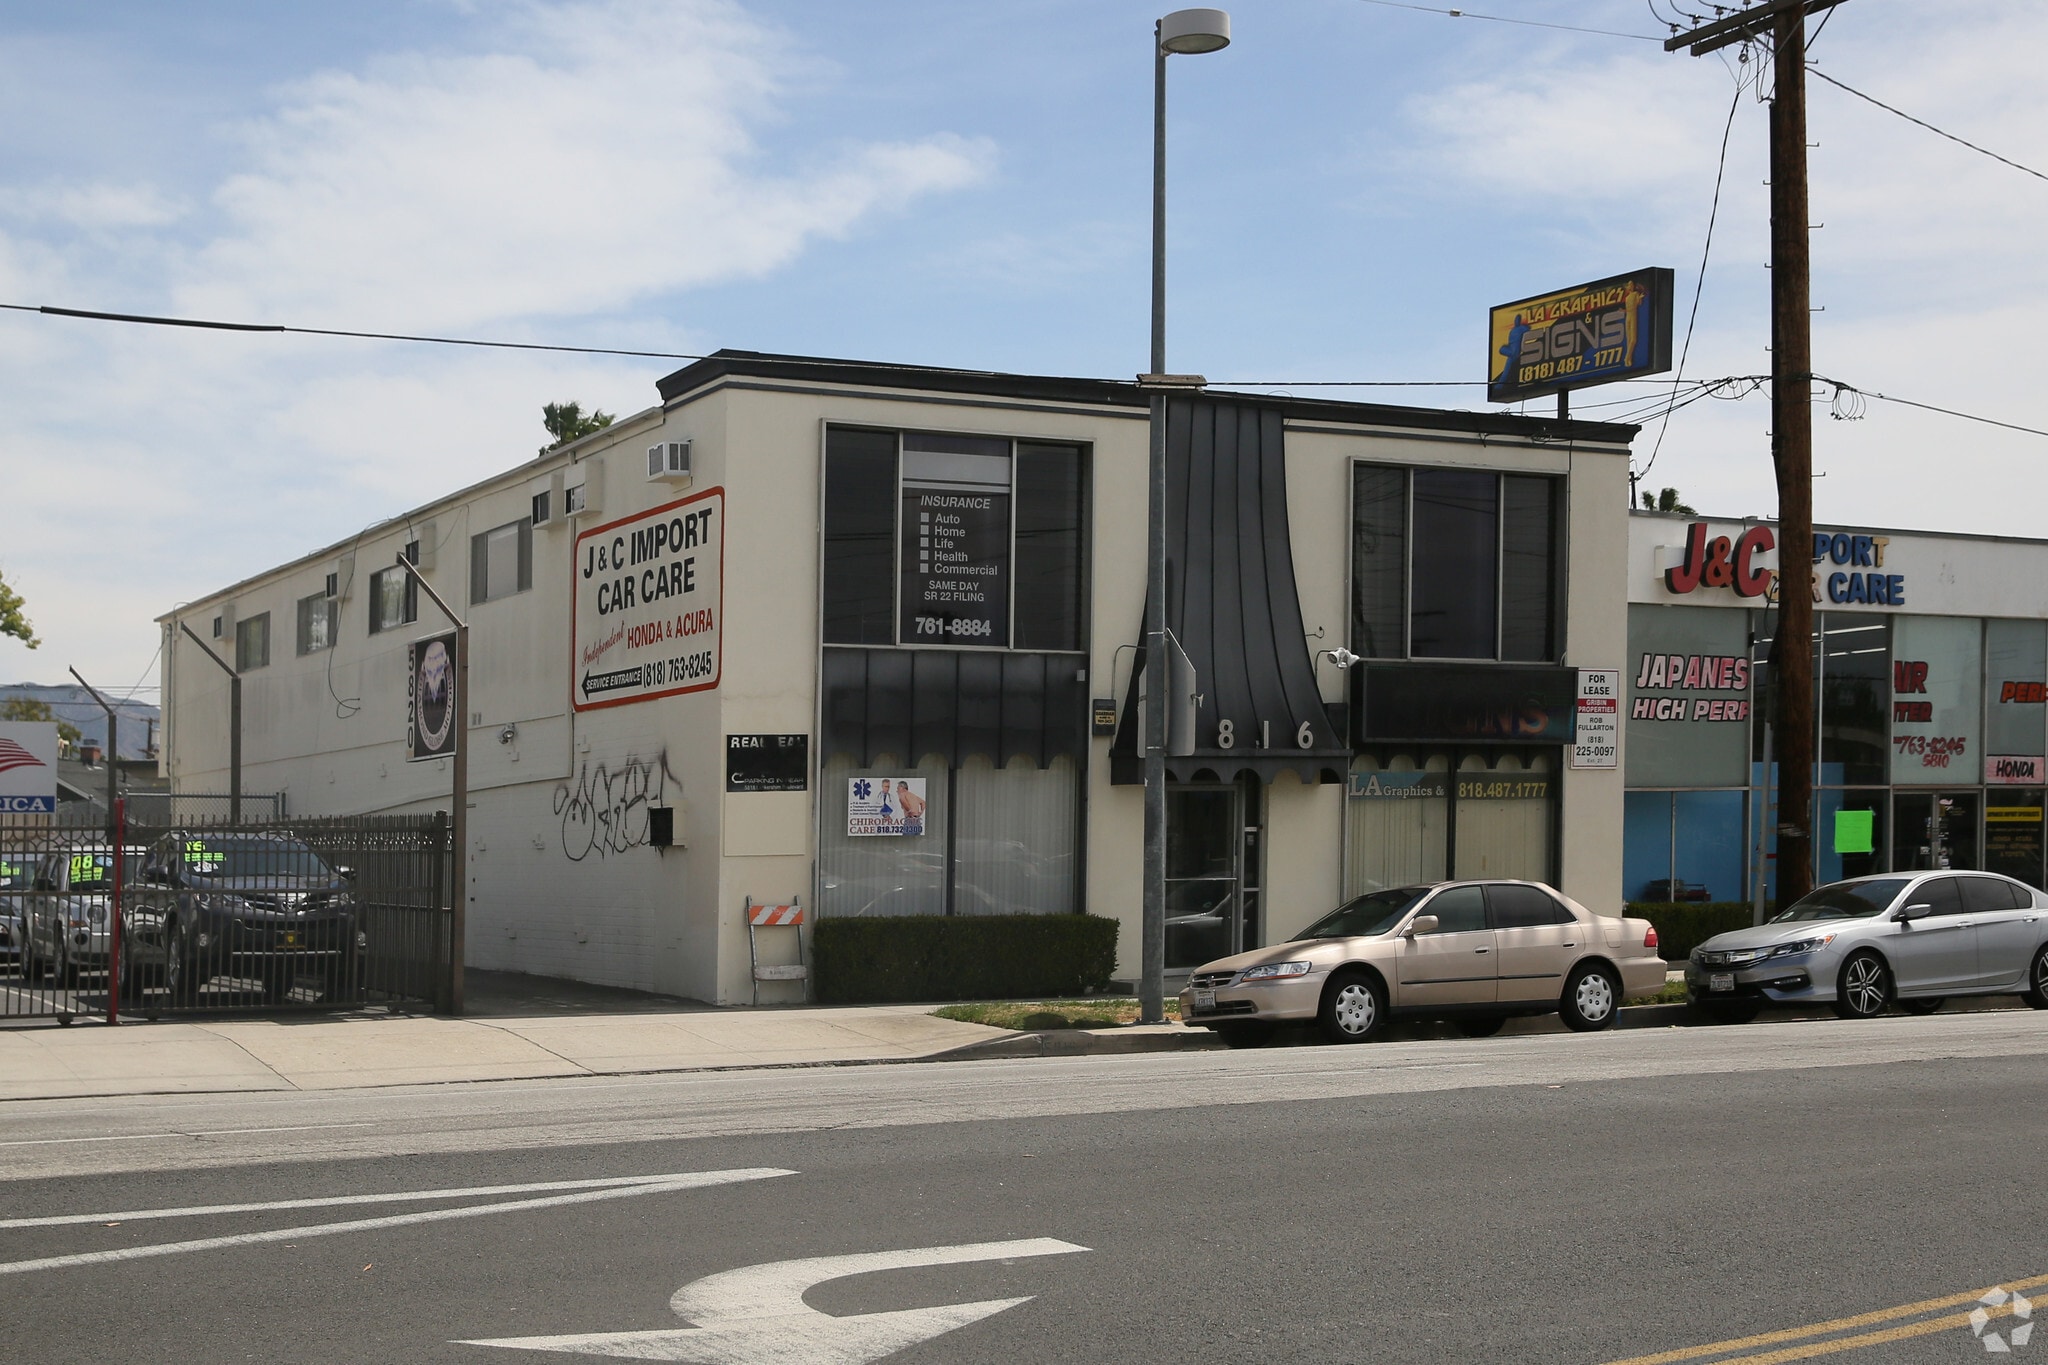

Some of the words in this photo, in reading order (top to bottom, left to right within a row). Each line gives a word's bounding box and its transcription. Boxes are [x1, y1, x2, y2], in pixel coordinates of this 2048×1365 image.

[1527, 306, 1544, 324] LA
[1550, 287, 1625, 319] GRAPHICS
[1585, 312, 1592, 323] &
[1520, 310, 1625, 365] SIGNS
[1519, 361, 1554, 383] (818)
[1557, 356, 1582, 375] 487
[1594, 347, 1622, 367] 1777
[920, 495, 990, 509] INSURANCE
[935, 513, 960, 524] Auto
[934, 526, 965, 536] Home
[584, 546, 594, 579] J
[598, 546, 607, 571] &
[612, 537, 624, 570] C
[631, 508, 712, 566] IMPORT
[934, 538, 954, 548] Life
[934, 551, 968, 562] Health
[1665, 523, 1775, 597] J&C
[934, 564, 998, 575] Commercial
[598, 575, 635, 615] CAR
[641, 557, 694, 603] CARE
[929, 581, 956, 589] SAME
[959, 582, 979, 591] DAY
[1764, 569, 1822, 603] CR
[1829, 572, 1904, 605] CARE
[924, 592, 937, 600] SR
[940, 592, 951, 600] 22
[954, 593, 984, 601] FILING
[915, 618, 991, 636] 761-8884
[582, 620, 624, 666] Independent
[628, 620, 663, 648] HONDA
[666, 620, 672, 638] &
[675, 608, 713, 638] ACURA
[586, 672, 609, 690] SERVICE
[610, 669, 641, 686] ENTRANCE
[643, 660, 666, 688] (818)
[668, 651, 712, 682] 763-8245
[1636, 653, 1748, 691] JAPANES
[1589, 675, 1605, 683] FOR
[1584, 687, 1609, 695] LEASE
[1632, 697, 1688, 721] HIGH
[1576, 747, 1614, 756] 225-0097
[1922, 754, 1949, 768] 5810
[1996, 760, 2034, 778] HONDA
[1350, 775, 1382, 796] LA
[1384, 786, 1432, 798] Graphics
[1435, 786, 1444, 796] &
[1459, 782, 1547, 798] 818.487.1777
[0, 798, 47, 811] ICA
